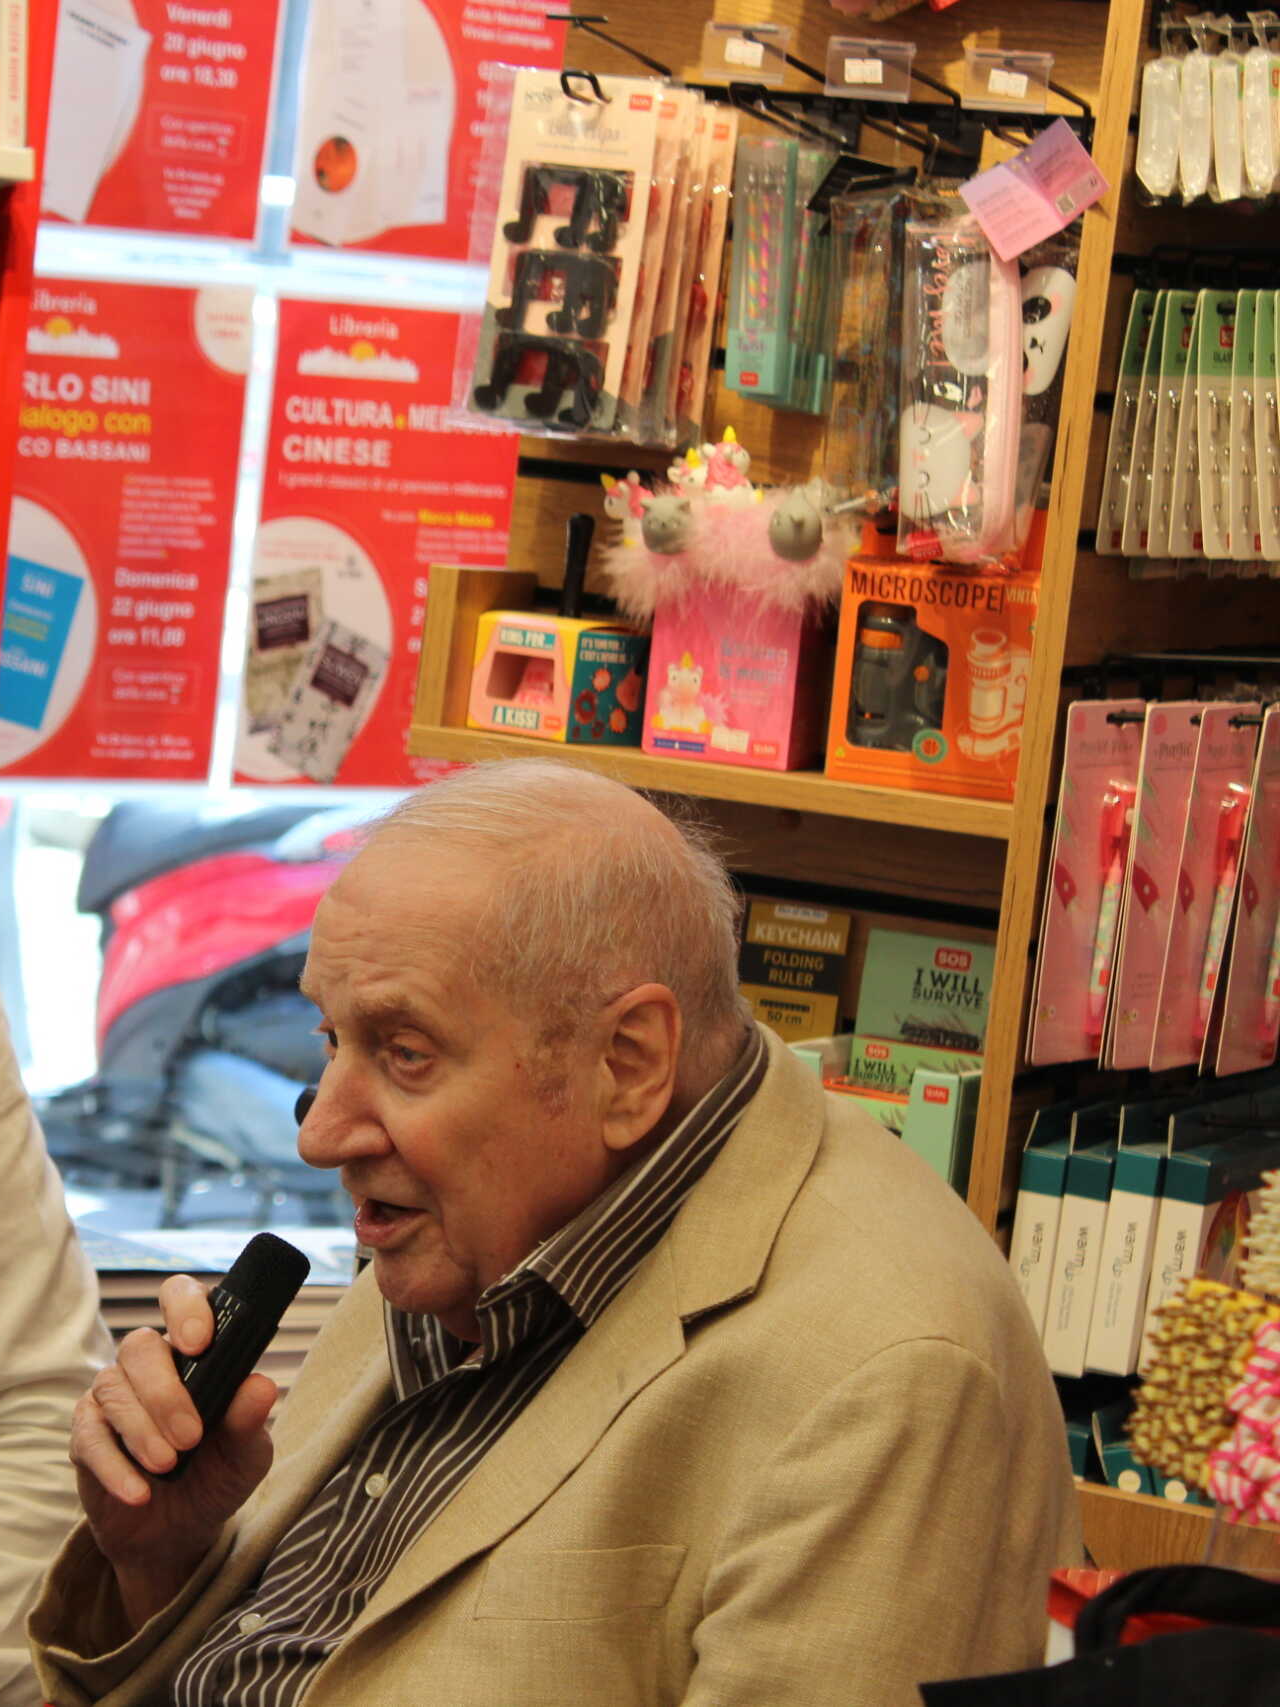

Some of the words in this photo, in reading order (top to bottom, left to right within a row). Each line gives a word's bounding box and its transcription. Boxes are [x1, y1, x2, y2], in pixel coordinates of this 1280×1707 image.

[32, 290, 97, 316] ibreria
[329, 314, 399, 340] Libreria
[23, 371, 84, 402] RLO
[90, 376, 150, 406] SINI
[104, 411, 151, 434] con
[285, 395, 394, 429] CULTURA
[55, 438, 150, 463] BASSANI
[282, 435, 392, 467] CINESE
[115, 567, 199, 591] Domenica
[850, 570, 1000, 613] MICROSCOPE
[135, 602, 194, 622] giugno
[108, 629, 135, 646] ore
[754, 921, 841, 949] KEYCHAIN
[763, 949, 824, 972] FOLDING
[937, 951, 968, 969] SOS
[768, 967, 814, 987] RULER
[914, 967, 923, 987] I
[930, 970, 984, 997] WILL
[911, 986, 985, 1009] SURVIVE
[785, 1014, 802, 1025] cm
[864, 1059, 895, 1075] WILL
[1029, 1221, 1045, 1264] warm
[1074, 1226, 1090, 1268] warm
[1122, 1221, 1138, 1264] warm
[1173, 1229, 1188, 1273] warm
